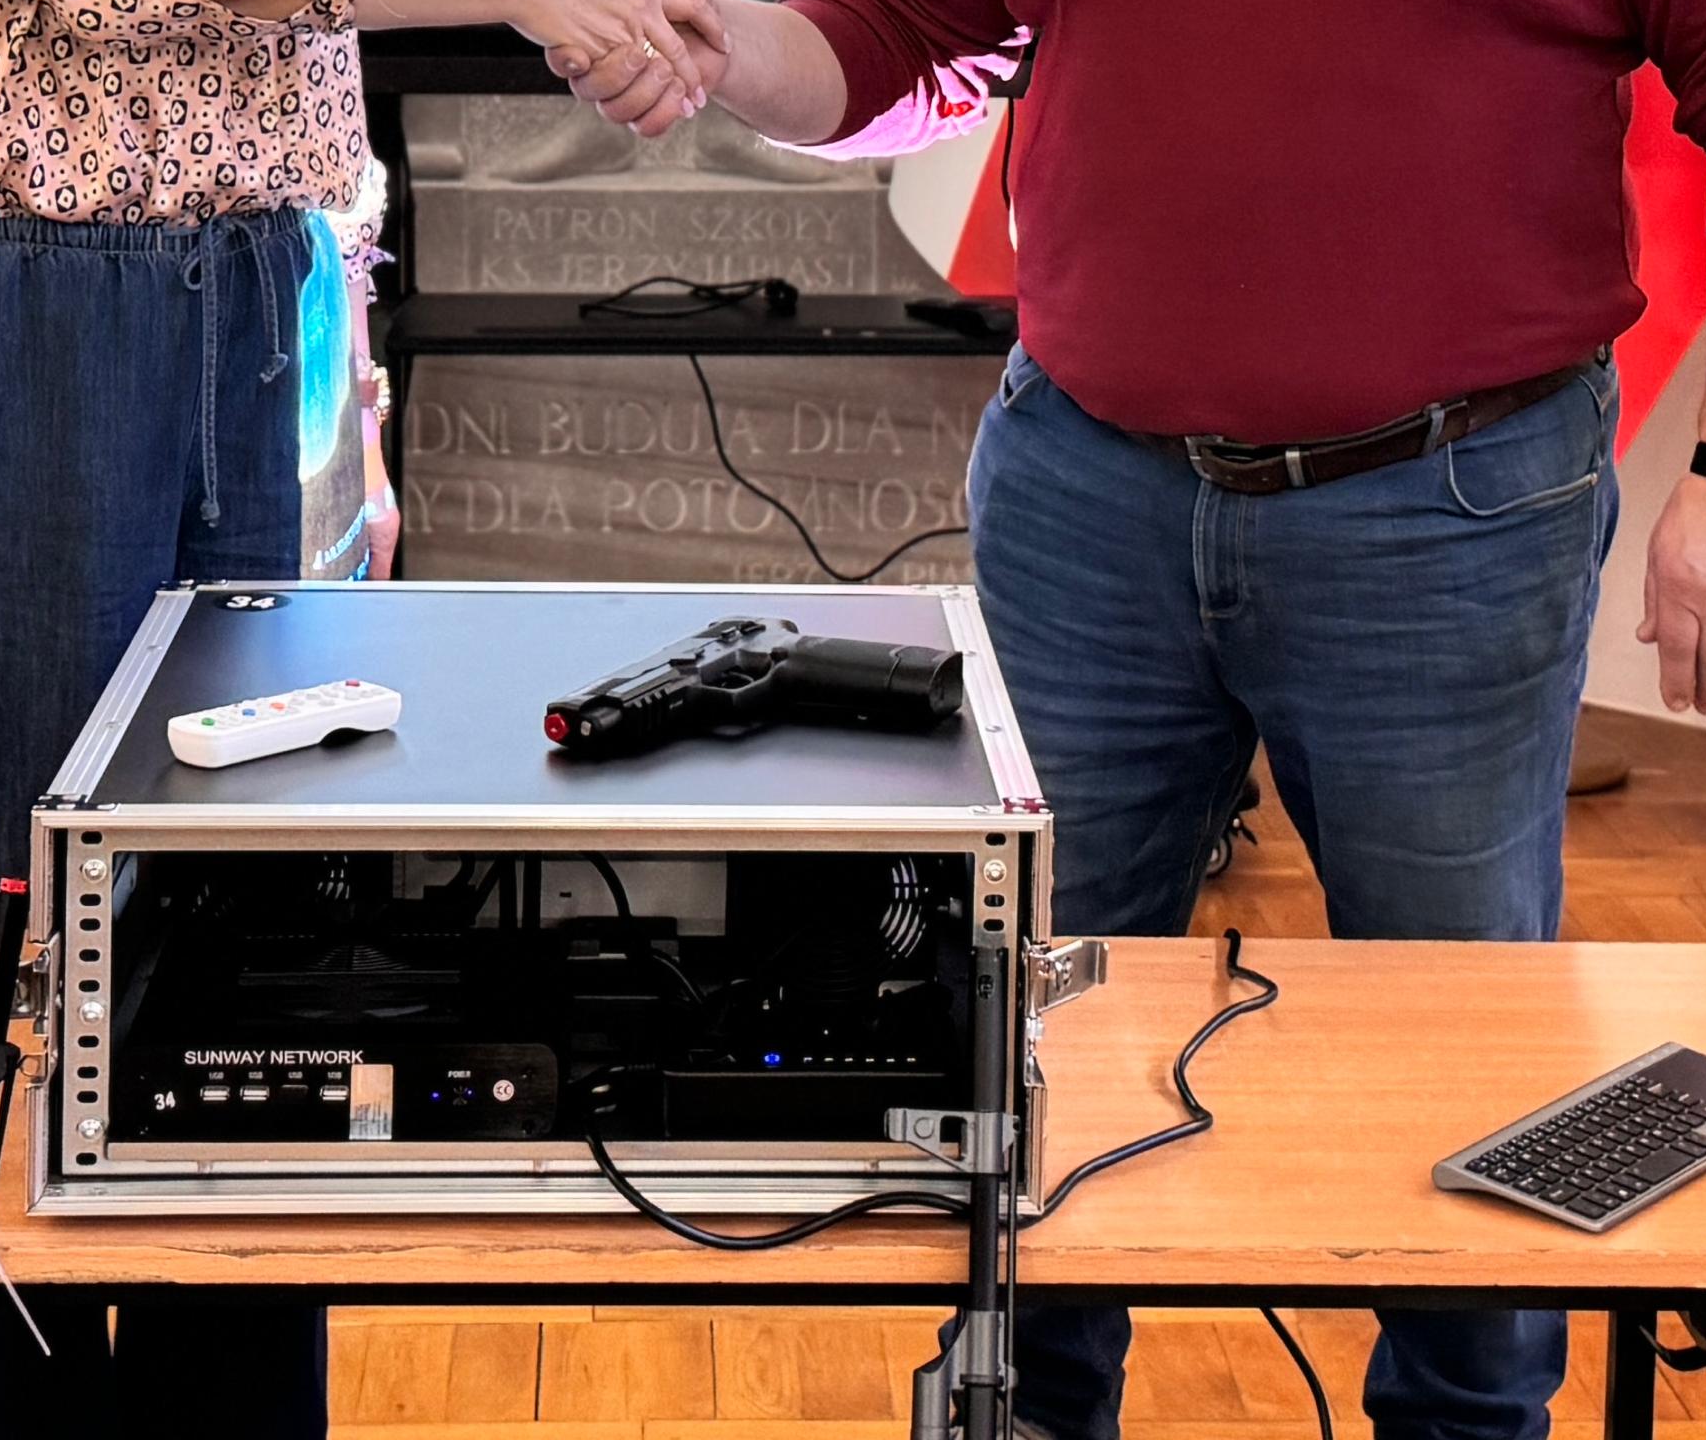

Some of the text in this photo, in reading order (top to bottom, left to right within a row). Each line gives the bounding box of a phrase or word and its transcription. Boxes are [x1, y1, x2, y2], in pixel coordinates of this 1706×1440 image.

[492, 207, 842, 243] PATRON SZKOŁY
[790, 400, 904, 457] DLA
[464, 478, 574, 534] DLA
[225, 595, 276, 609] 34
[184, 1050, 364, 1065] SUNWAY NETWORK
[154, 1091, 176, 1110] 34
